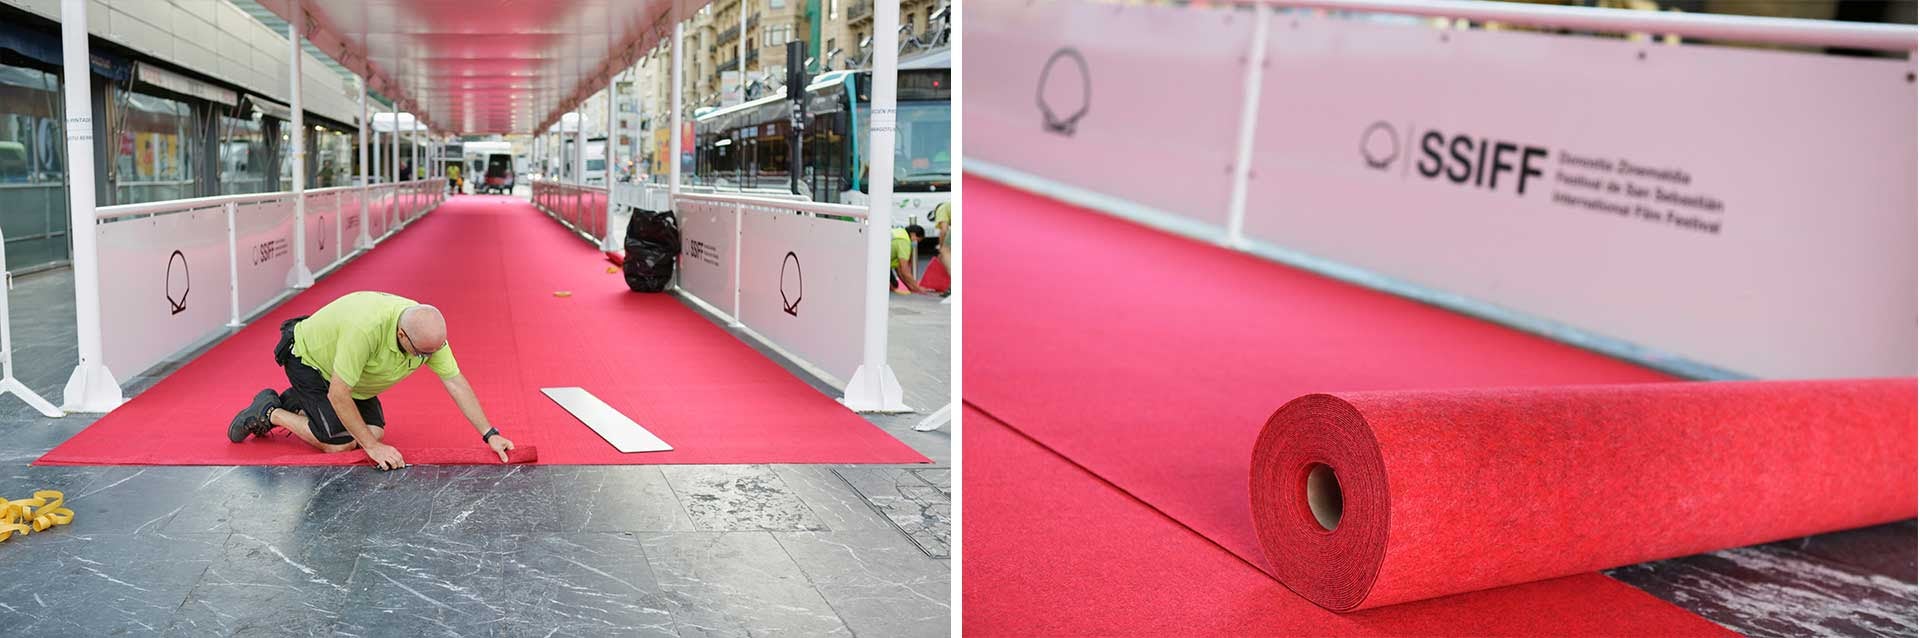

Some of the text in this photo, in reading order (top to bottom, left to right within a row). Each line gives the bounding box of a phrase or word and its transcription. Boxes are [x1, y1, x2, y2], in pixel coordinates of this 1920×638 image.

[1417, 130, 1548, 195] SSIFF
[1556, 170, 1602, 190] Festival
[1607, 180, 1621, 192] de
[1626, 183, 1650, 197] San
[1553, 192, 1720, 234] International Film Festival
